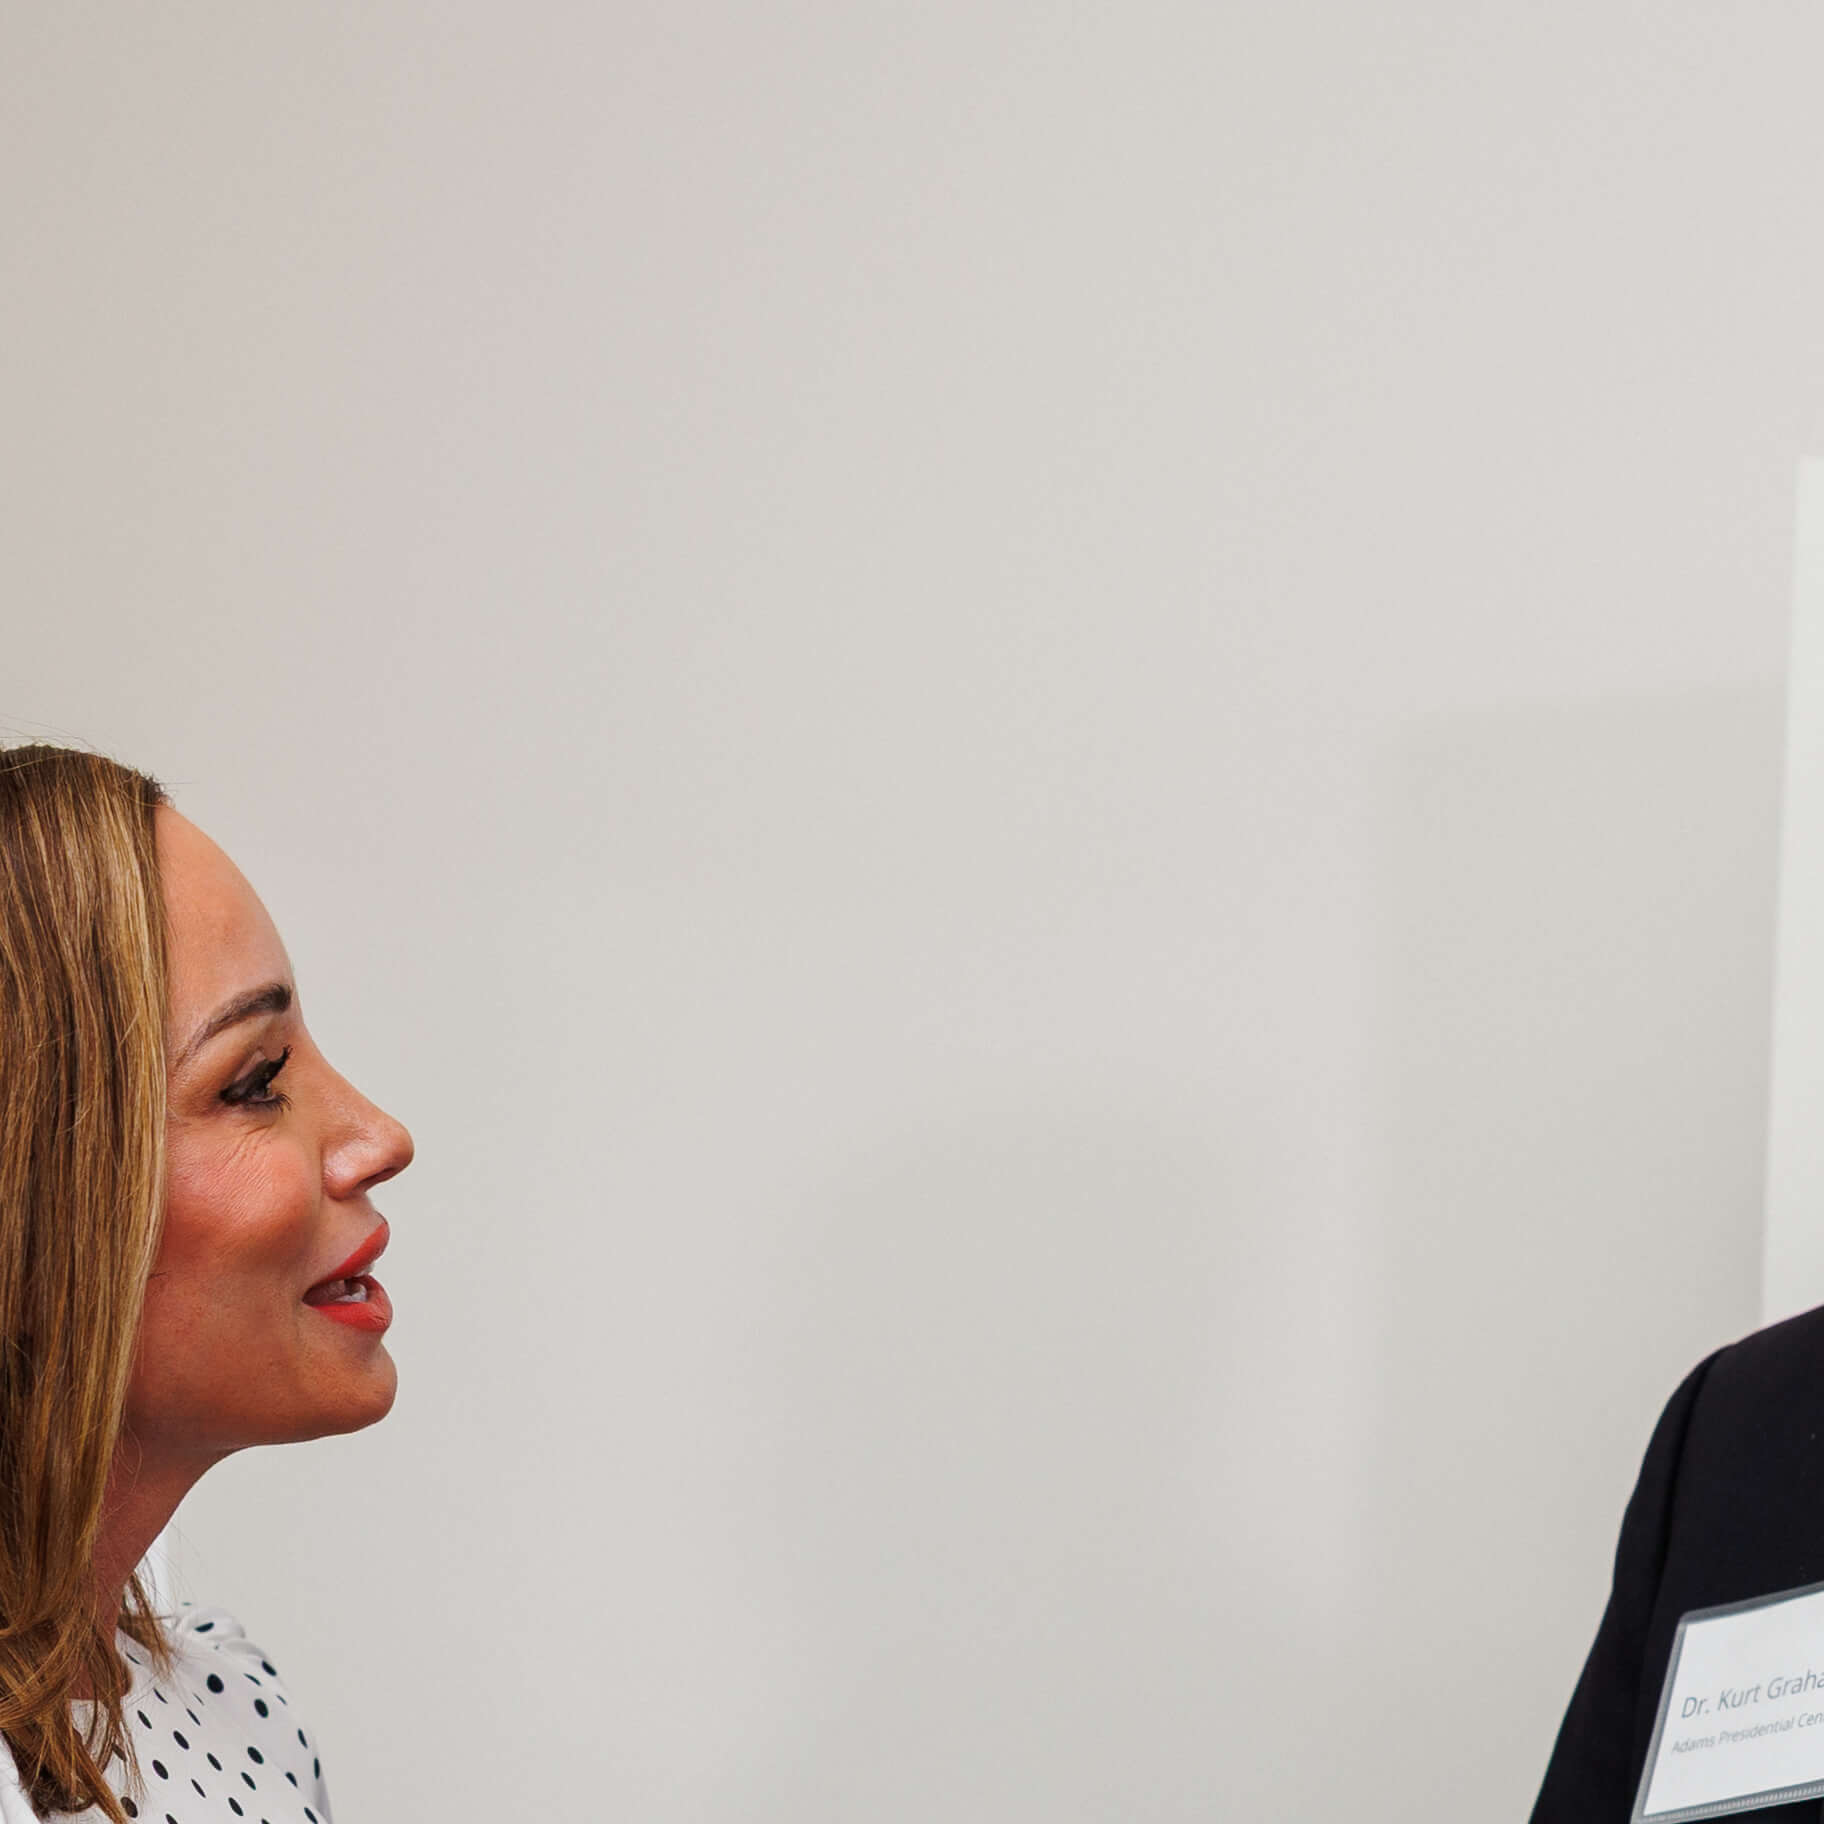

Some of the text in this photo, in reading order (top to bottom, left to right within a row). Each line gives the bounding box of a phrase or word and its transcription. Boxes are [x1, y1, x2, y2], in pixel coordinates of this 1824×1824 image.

[1681, 1697, 1710, 1718] Dr.
[1717, 1684, 1761, 1711] Kurt
[1717, 1717, 1794, 1746] Presidential
